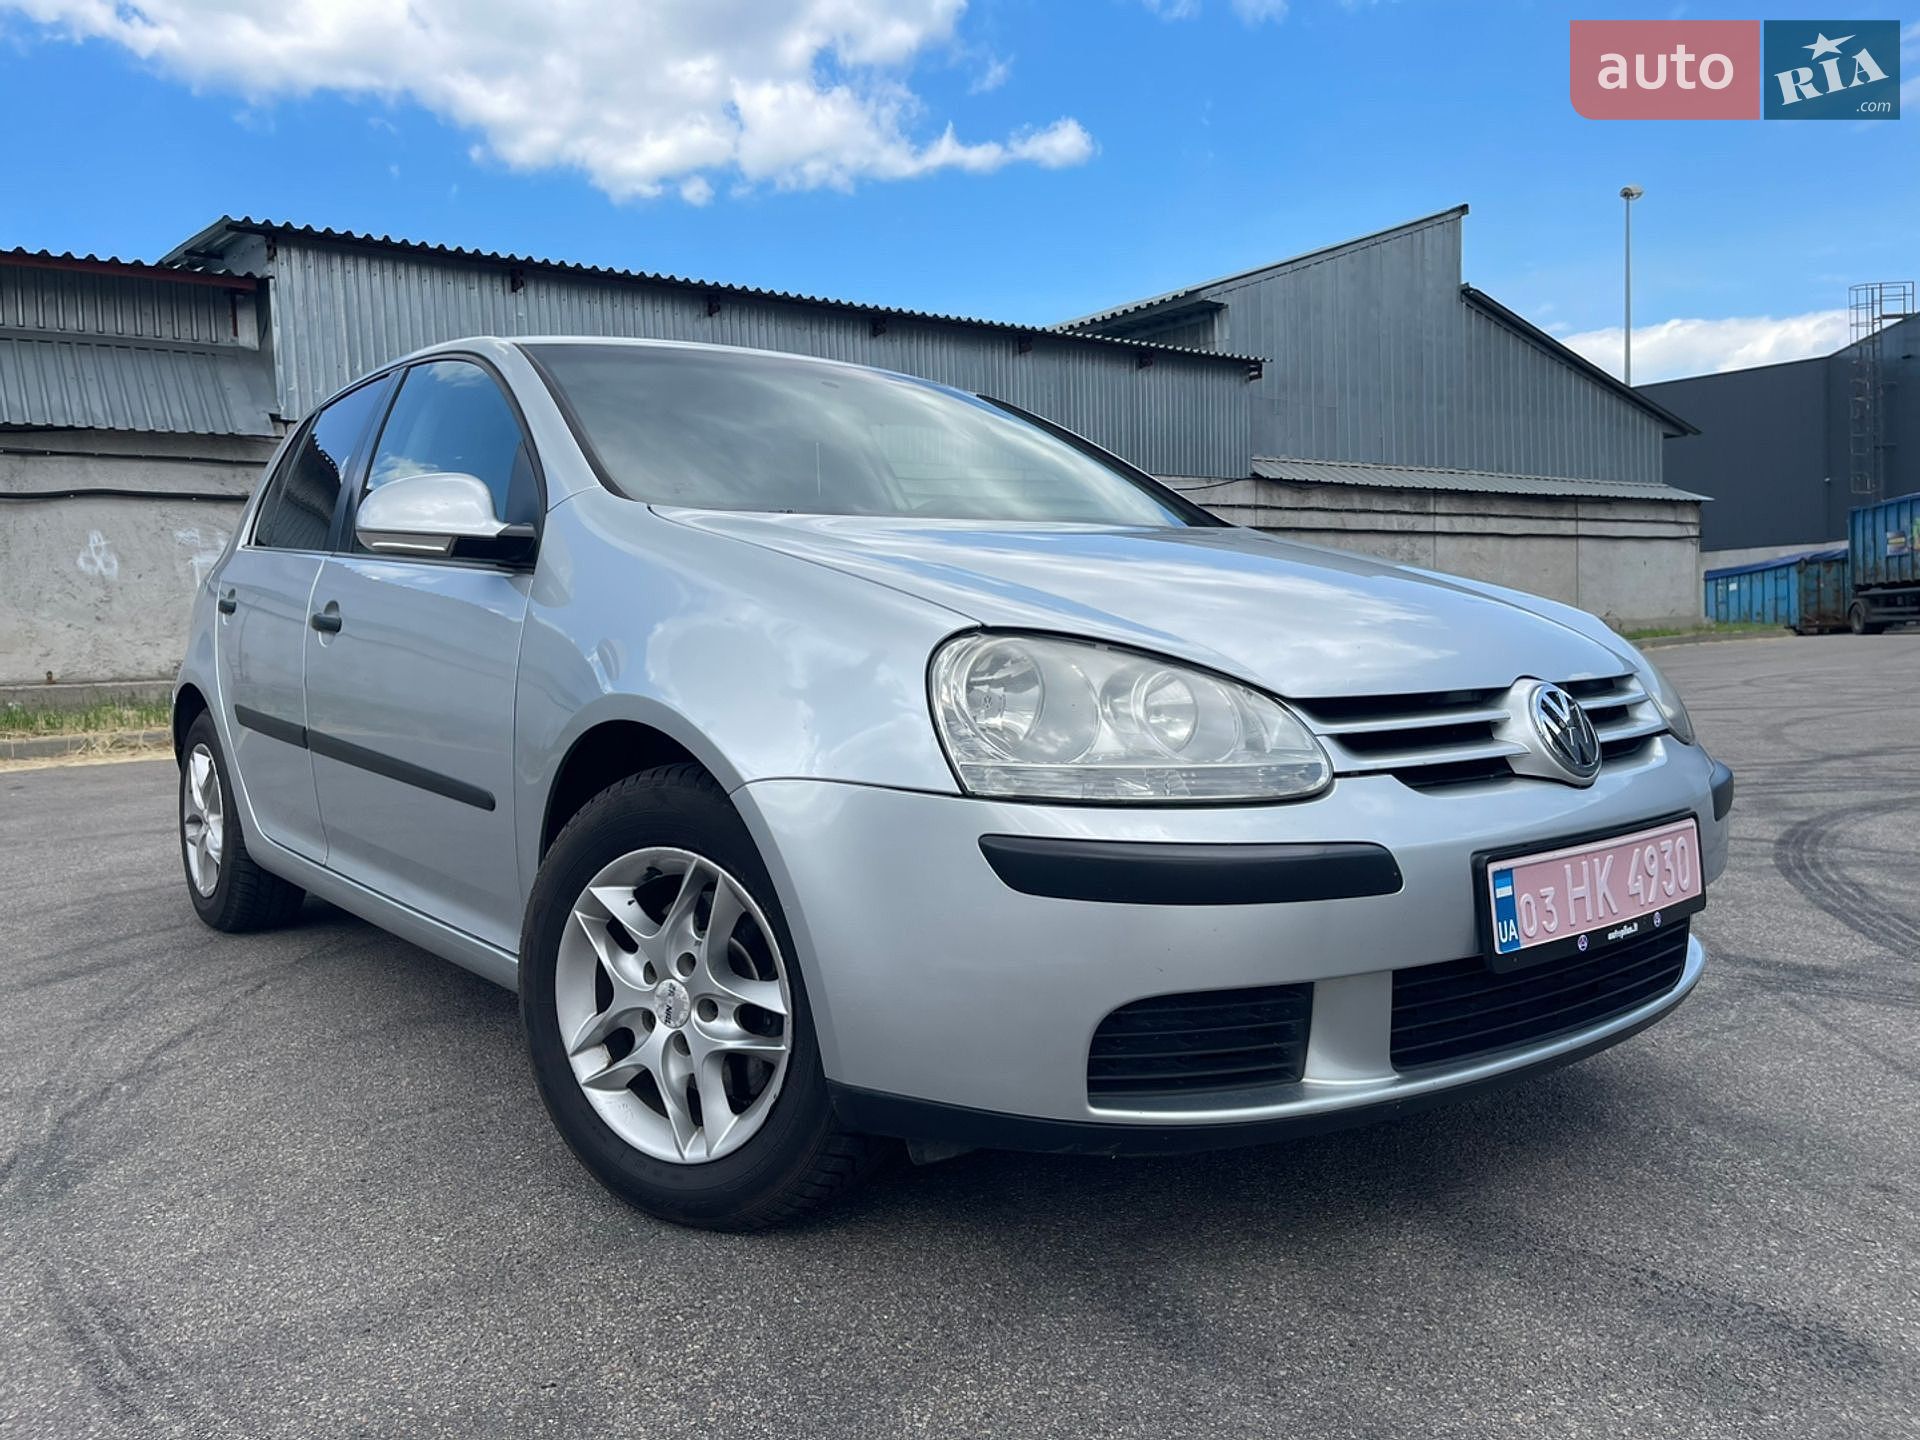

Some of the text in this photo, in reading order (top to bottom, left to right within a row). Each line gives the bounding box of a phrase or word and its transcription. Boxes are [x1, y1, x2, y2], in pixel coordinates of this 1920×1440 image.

[1519, 836, 1691, 938] 03 HK 4930
[1498, 919, 1519, 944] UA
